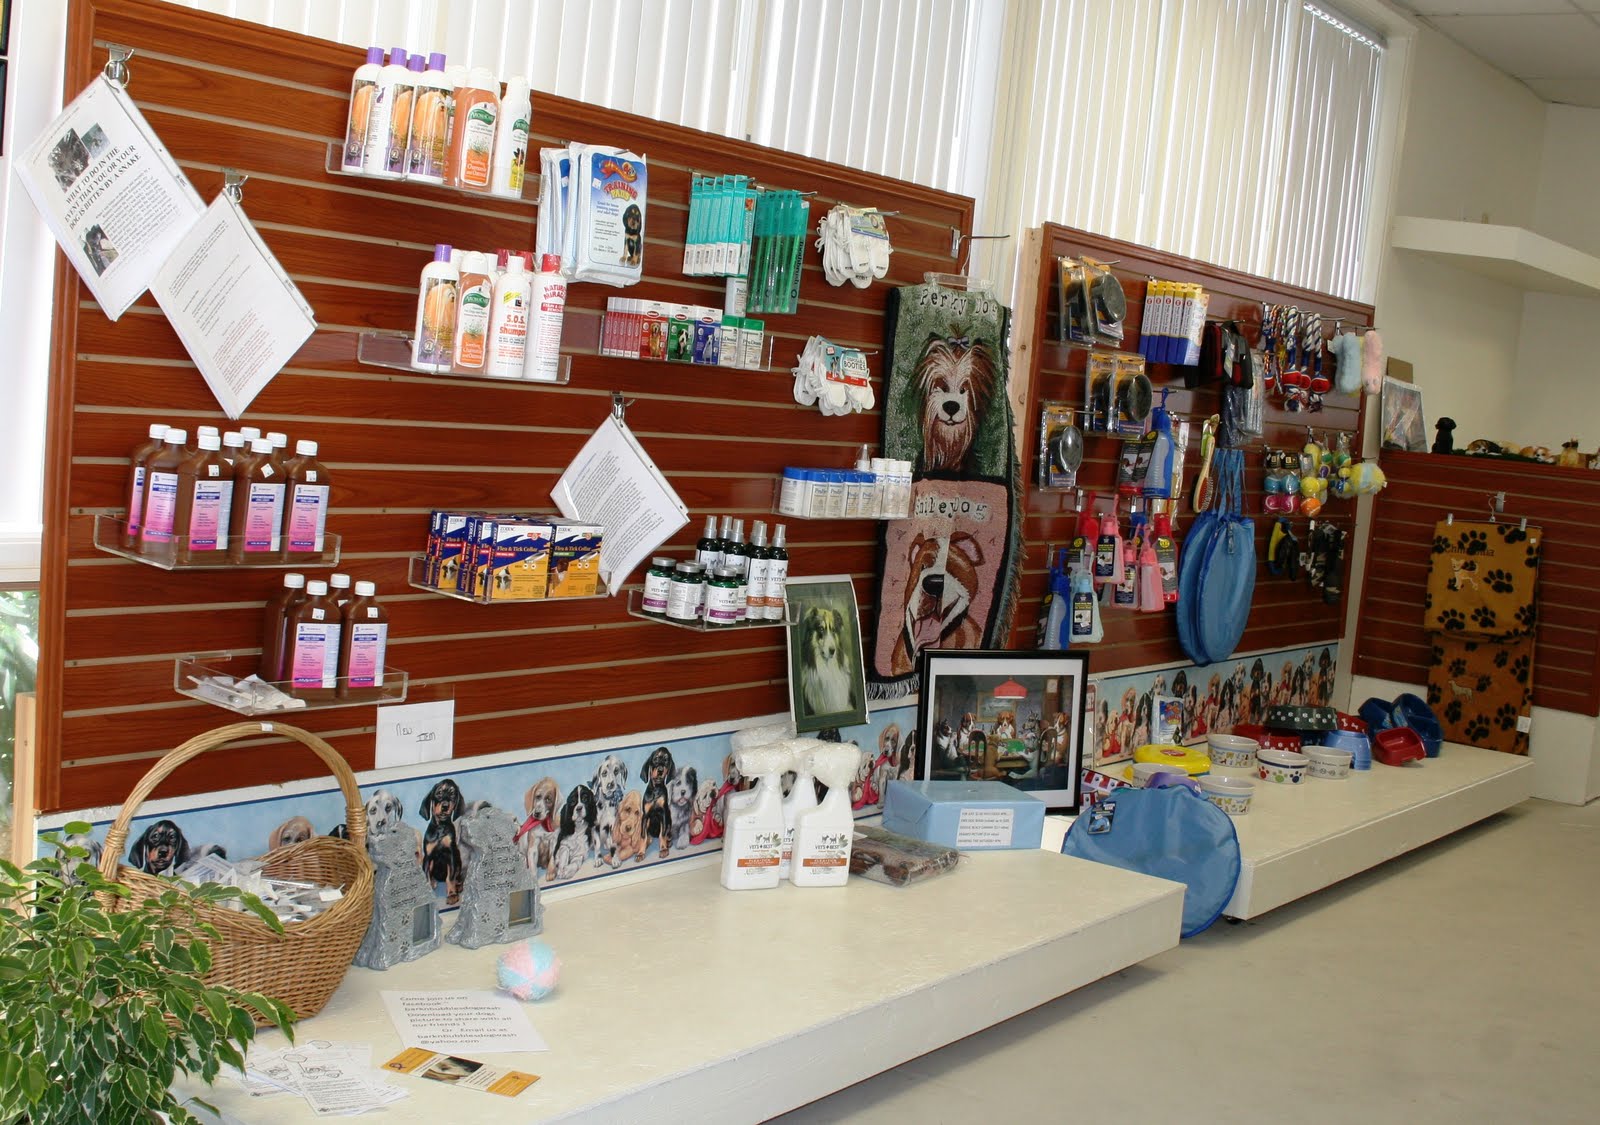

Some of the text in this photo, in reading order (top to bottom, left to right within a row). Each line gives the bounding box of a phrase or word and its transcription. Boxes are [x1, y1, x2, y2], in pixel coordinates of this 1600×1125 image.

[64, 145, 136, 222] EVENT THAT YOU OR YOUR
[65, 146, 120, 204] WHAT TO DO IN THE
[69, 215, 81, 231] DOG
[84, 184, 106, 210] BITTEN
[105, 177, 114, 189] BY
[118, 153, 141, 174] SNAKE
[603, 181, 637, 200] TRAINING
[843, 361, 866, 371] BOOTIES
